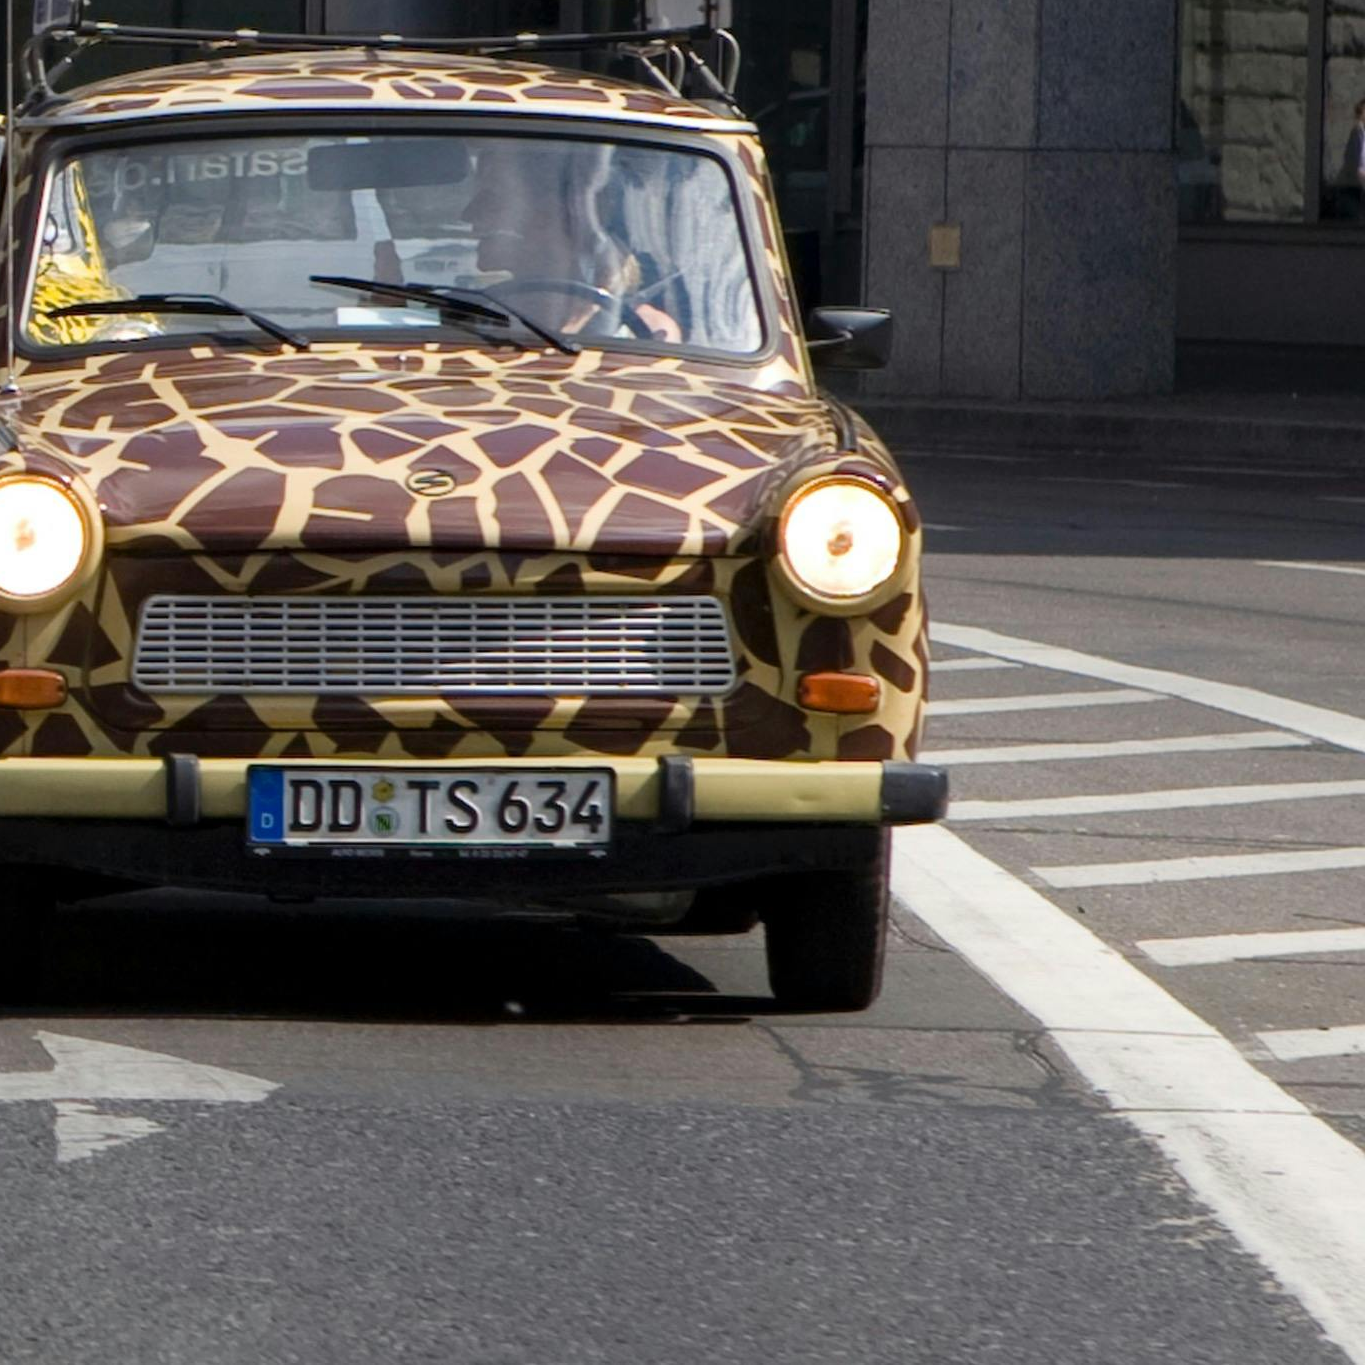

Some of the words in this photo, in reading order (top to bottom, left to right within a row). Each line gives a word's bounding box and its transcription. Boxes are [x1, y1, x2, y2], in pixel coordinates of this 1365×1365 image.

[261, 813, 274, 829] D
[288, 779, 363, 833] DD
[407, 780, 480, 834] TS
[497, 780, 604, 835] 634
